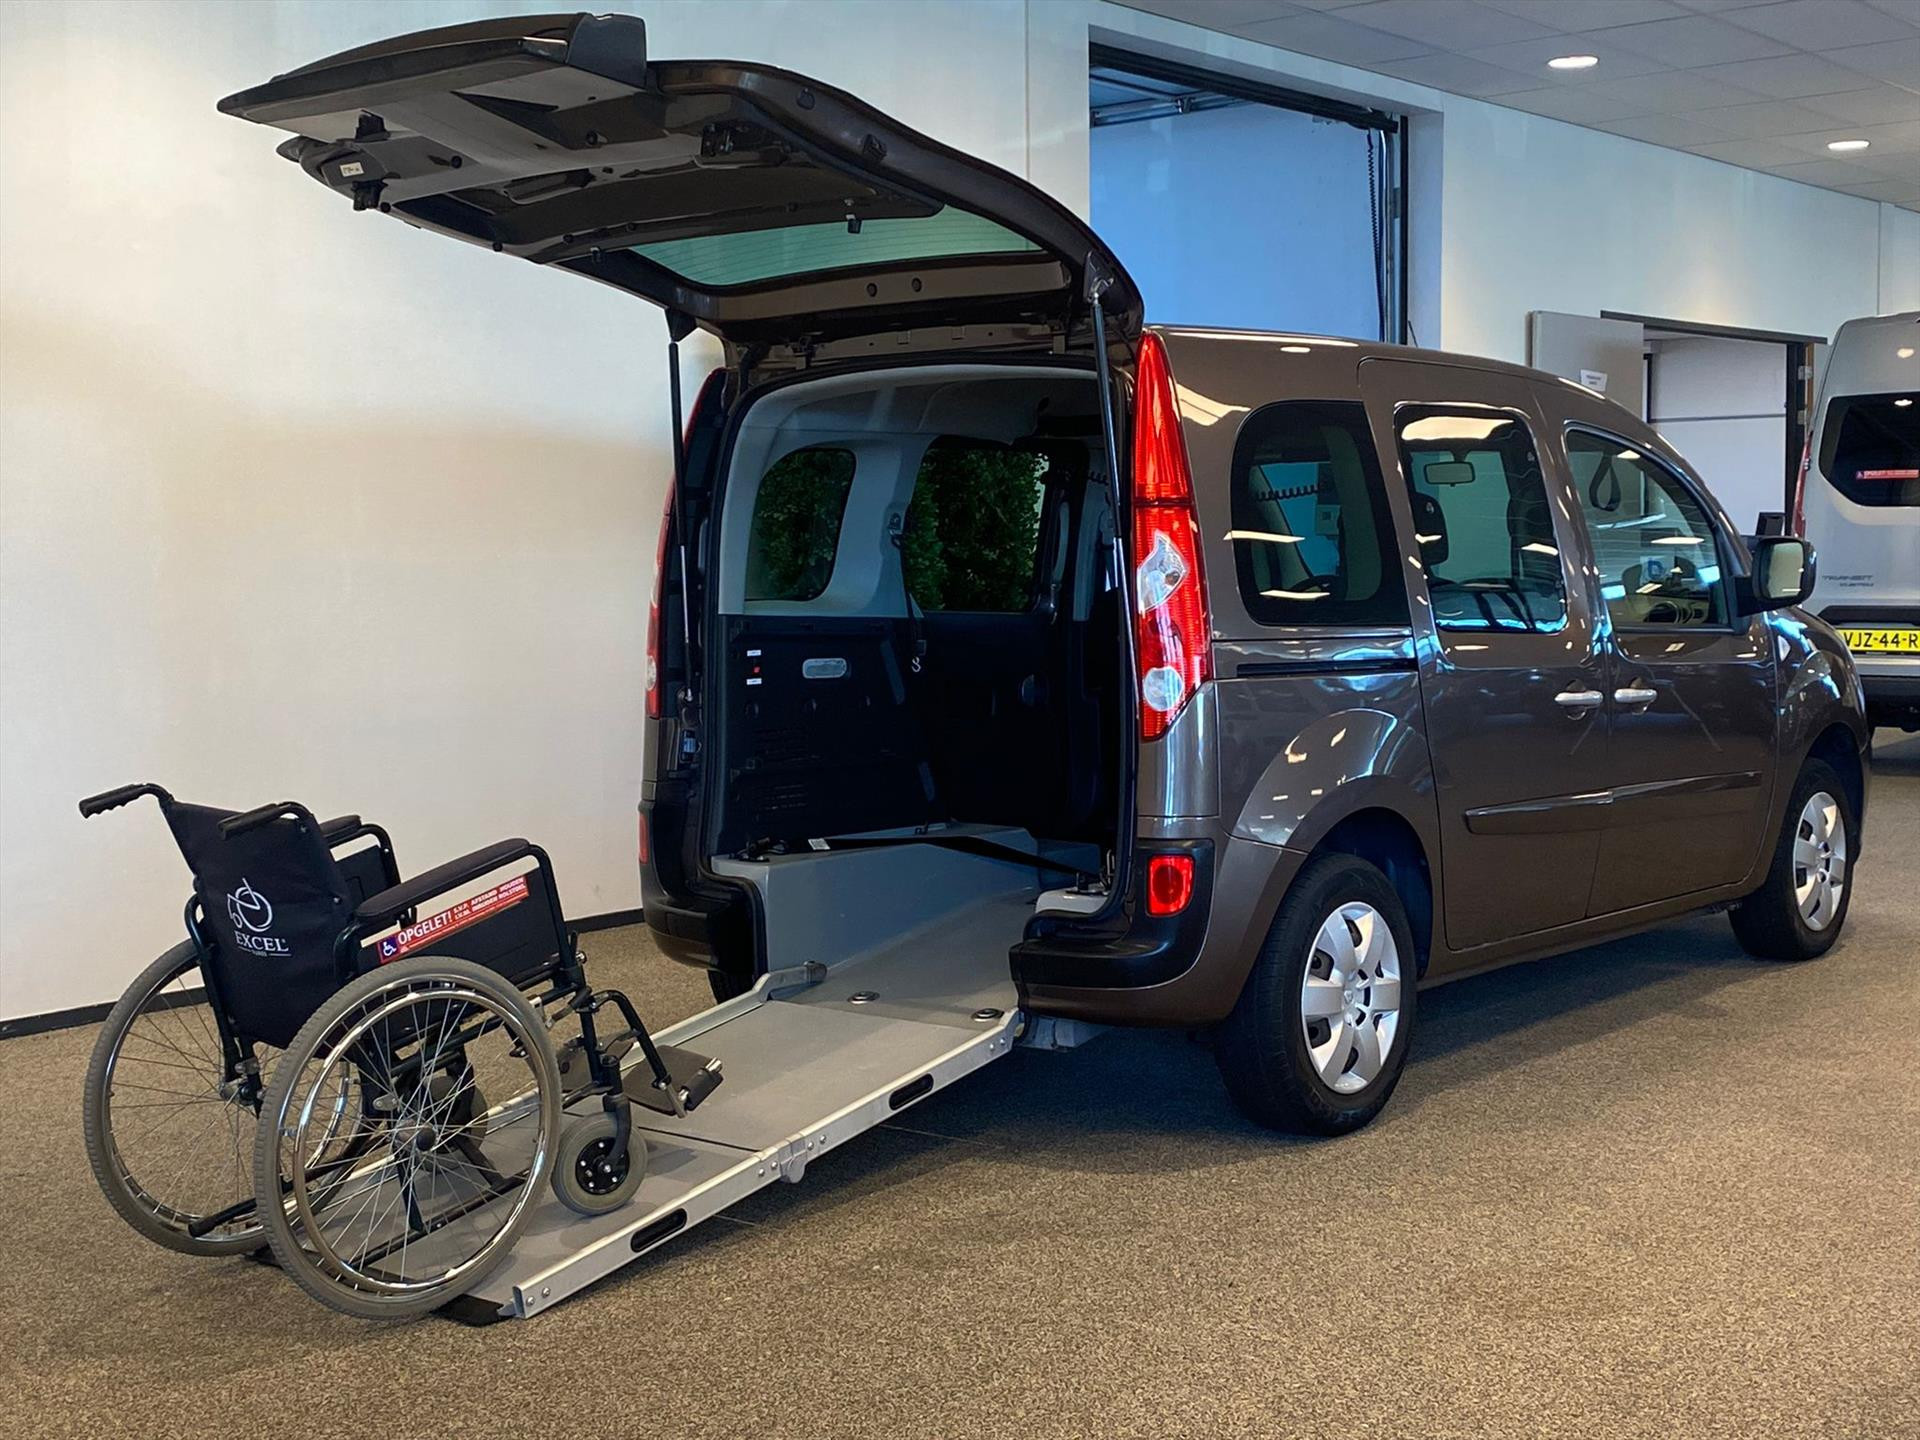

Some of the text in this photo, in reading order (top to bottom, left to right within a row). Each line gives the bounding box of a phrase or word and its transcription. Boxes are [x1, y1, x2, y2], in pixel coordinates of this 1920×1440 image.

[1842, 632, 1919, 648] VJZ-44-R
[398, 911, 452, 944] OPGELET!
[234, 930, 289, 952] EXCEL
